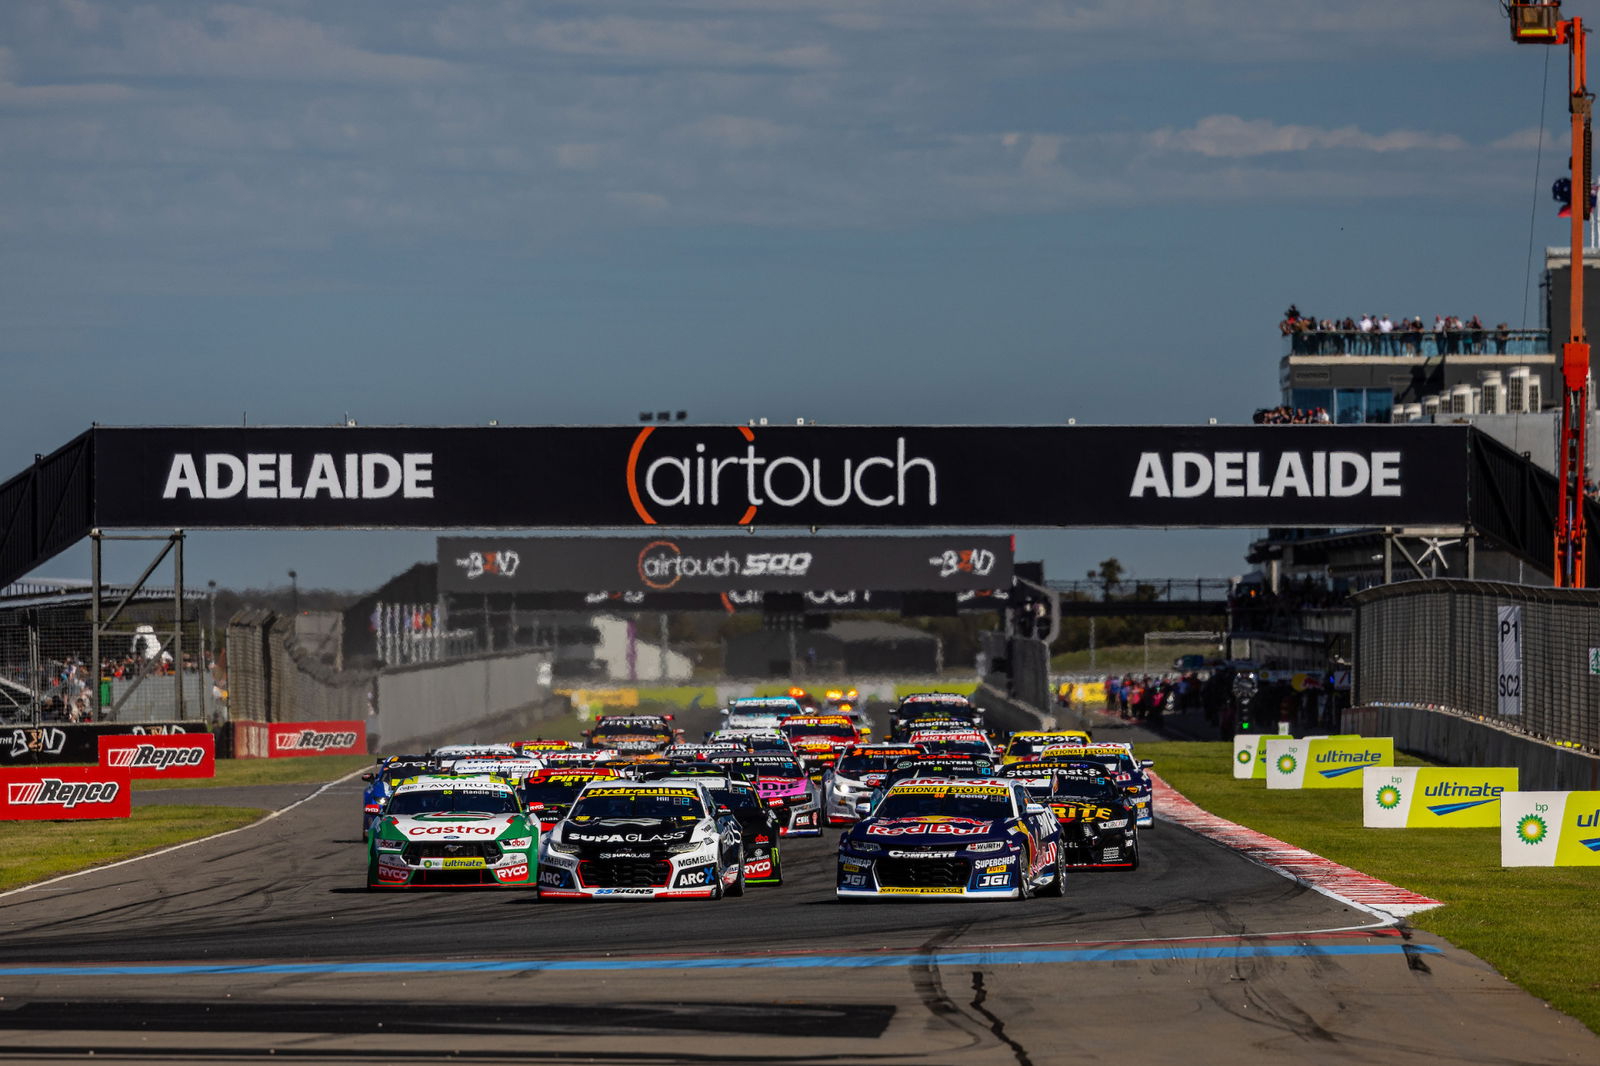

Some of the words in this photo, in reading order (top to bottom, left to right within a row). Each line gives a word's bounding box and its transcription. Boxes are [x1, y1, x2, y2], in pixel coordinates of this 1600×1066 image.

[162, 452, 434, 499] ADELAIDE
[645, 437, 937, 506] airtouch
[1129, 451, 1401, 498] ADELAIDE
[643, 551, 740, 577] airtouch
[741, 552, 813, 576] 500
[1500, 620, 1519, 642] P1
[1499, 674, 1520, 697] SC2
[298, 729, 357, 751] Repco
[130, 744, 205, 770] Repco
[1315, 750, 1382, 763] ultimate
[1006, 768, 1082, 777] Steadfast
[453, 782, 508, 790] TRUCKS
[1391, 775, 1403, 784] bp
[34, 778, 120, 808] Repco
[587, 787, 697, 796] Hydraulink
[891, 786, 945, 794] NATIONAL
[949, 786, 1008, 795] STORAGE
[1424, 782, 1505, 797] ultimate
[1535, 803, 1549, 813] bp
[409, 825, 496, 836] Castrol
[866, 823, 929, 836] Red
[929, 822, 992, 835] Bull
[511, 838, 526, 847] dba
[888, 850, 958, 859] COMPLETE
[444, 859, 483, 867] ultimate
[743, 861, 771, 874] RYCO
[975, 855, 1016, 870] SUPERCHEAP
[378, 866, 409, 880] RYCO
[496, 866, 528, 878] RYCO
[842, 874, 867, 885] JGI
[979, 874, 1010, 887] JGI
